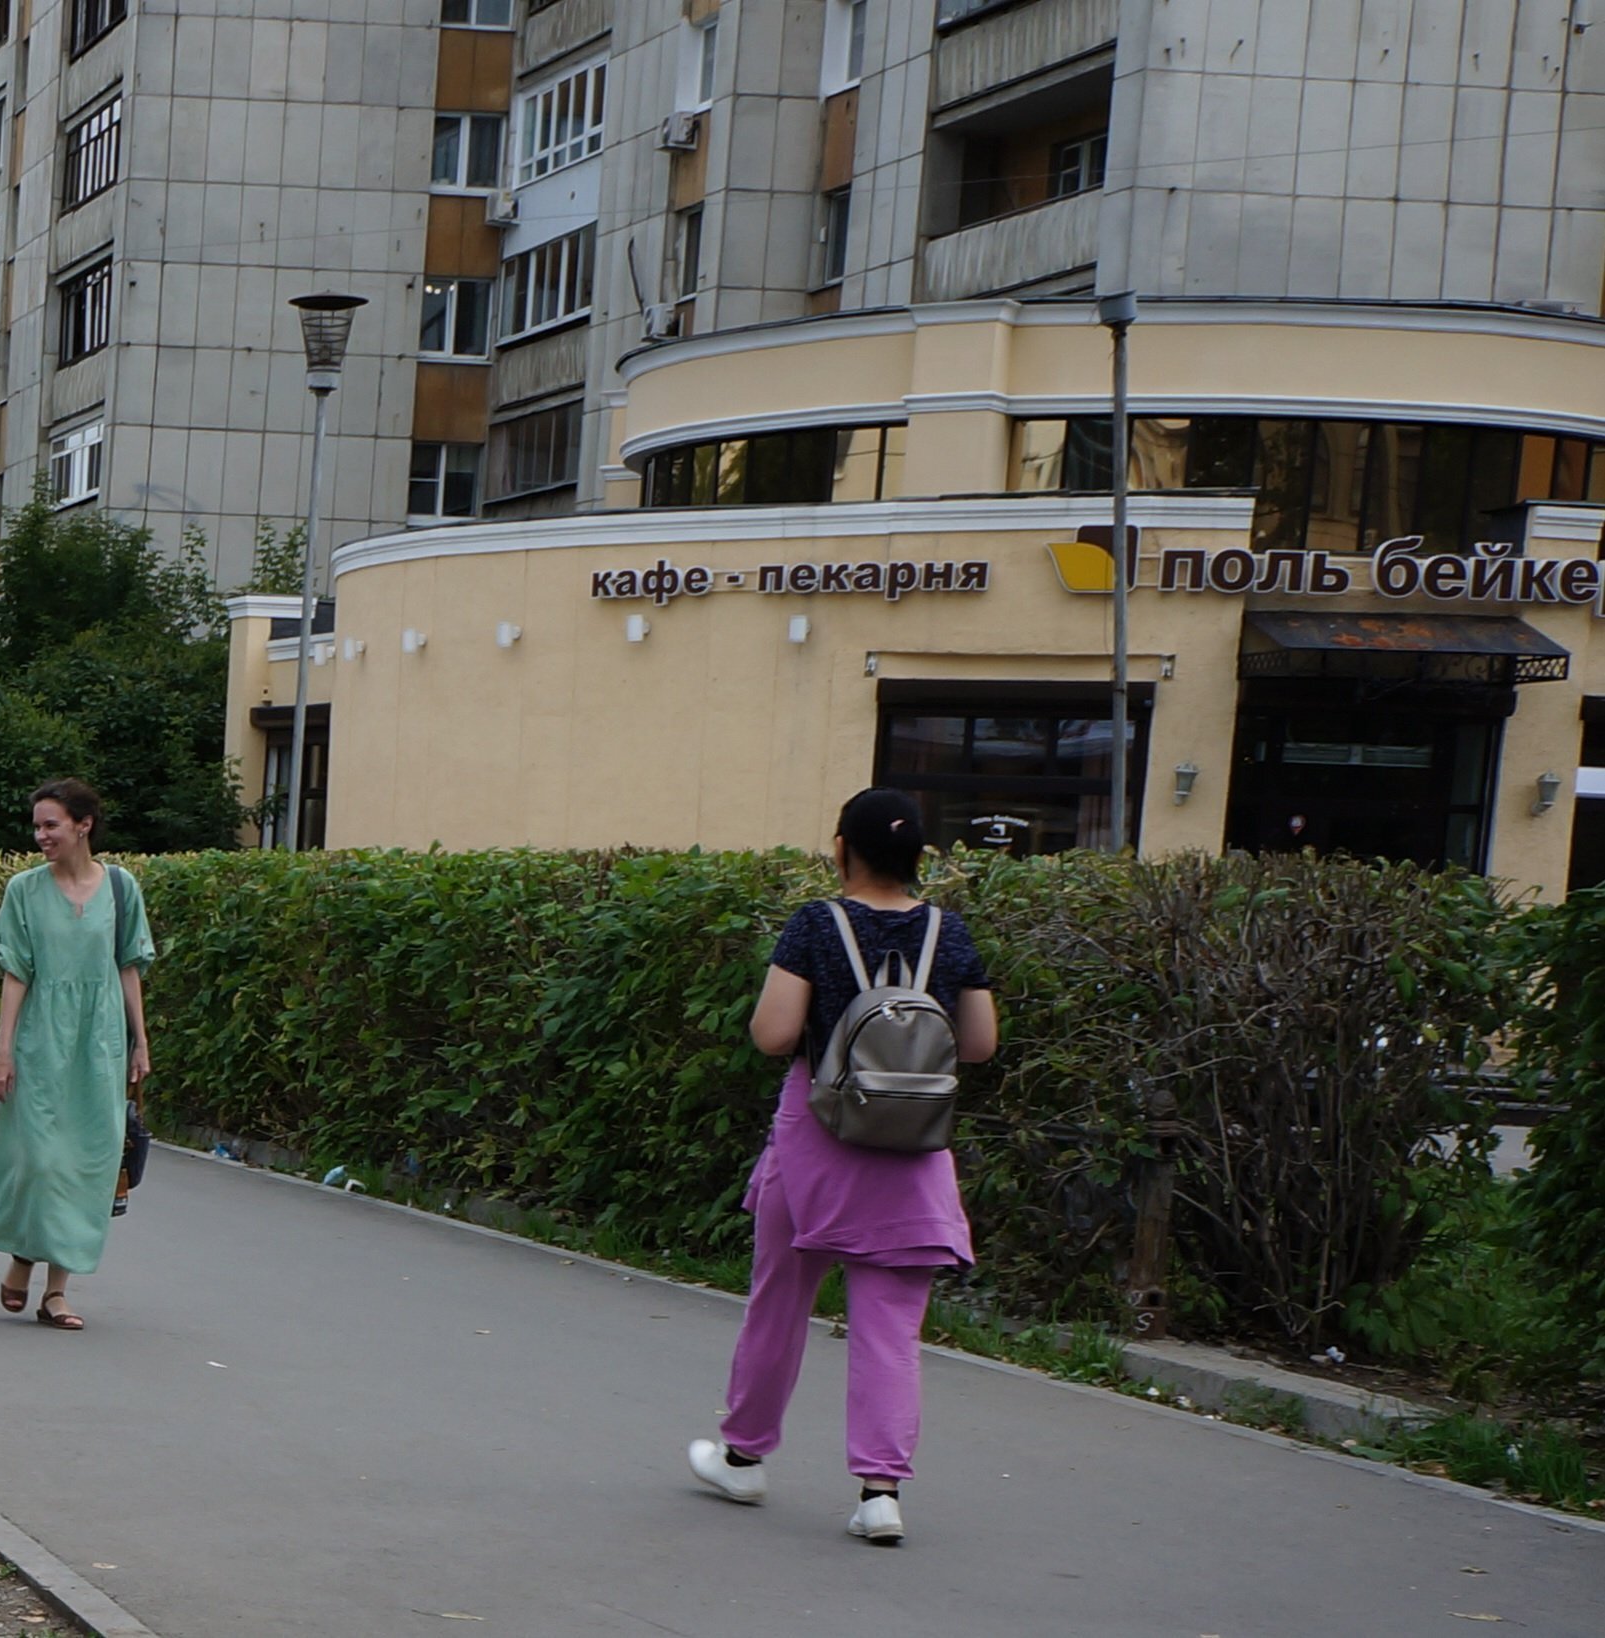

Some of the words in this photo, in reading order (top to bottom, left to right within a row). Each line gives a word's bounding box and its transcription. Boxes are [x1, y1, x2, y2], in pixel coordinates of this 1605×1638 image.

[591, 559, 713, 606] кафе
[757, 559, 990, 602] пекарня
[1158, 547, 1351, 595] поль
[1372, 535, 1605, 618] бейке
